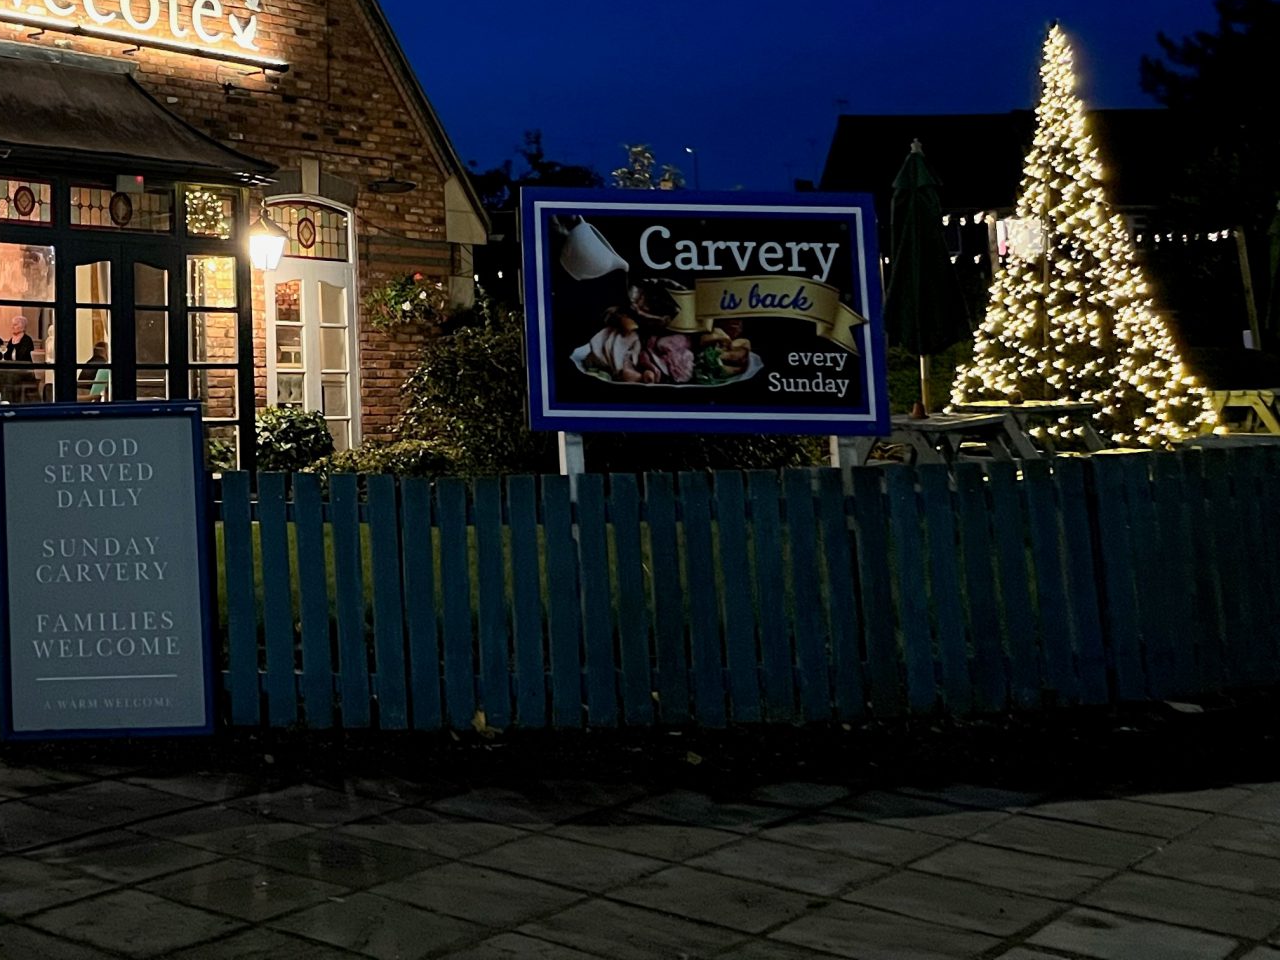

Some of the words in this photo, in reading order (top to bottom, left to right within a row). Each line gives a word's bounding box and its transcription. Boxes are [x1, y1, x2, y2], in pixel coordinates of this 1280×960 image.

[639, 225, 840, 282] Carvery
[720, 289, 742, 311] is
[747, 283, 813, 311] back
[787, 351, 848, 371] every
[768, 372, 850, 398] Sunday
[58, 438, 139, 458] FOOD
[43, 462, 154, 484] SERVED
[57, 488, 142, 508] DAILY
[42, 536, 160, 558] SUNDAY
[36, 562, 168, 584] CARVERY
[37, 611, 174, 633] FAMILIES
[32, 636, 181, 659] WELCOME
[44, 700, 52, 711] A
[56, 698, 98, 710] WARM
[103, 696, 173, 709] WELCOME
